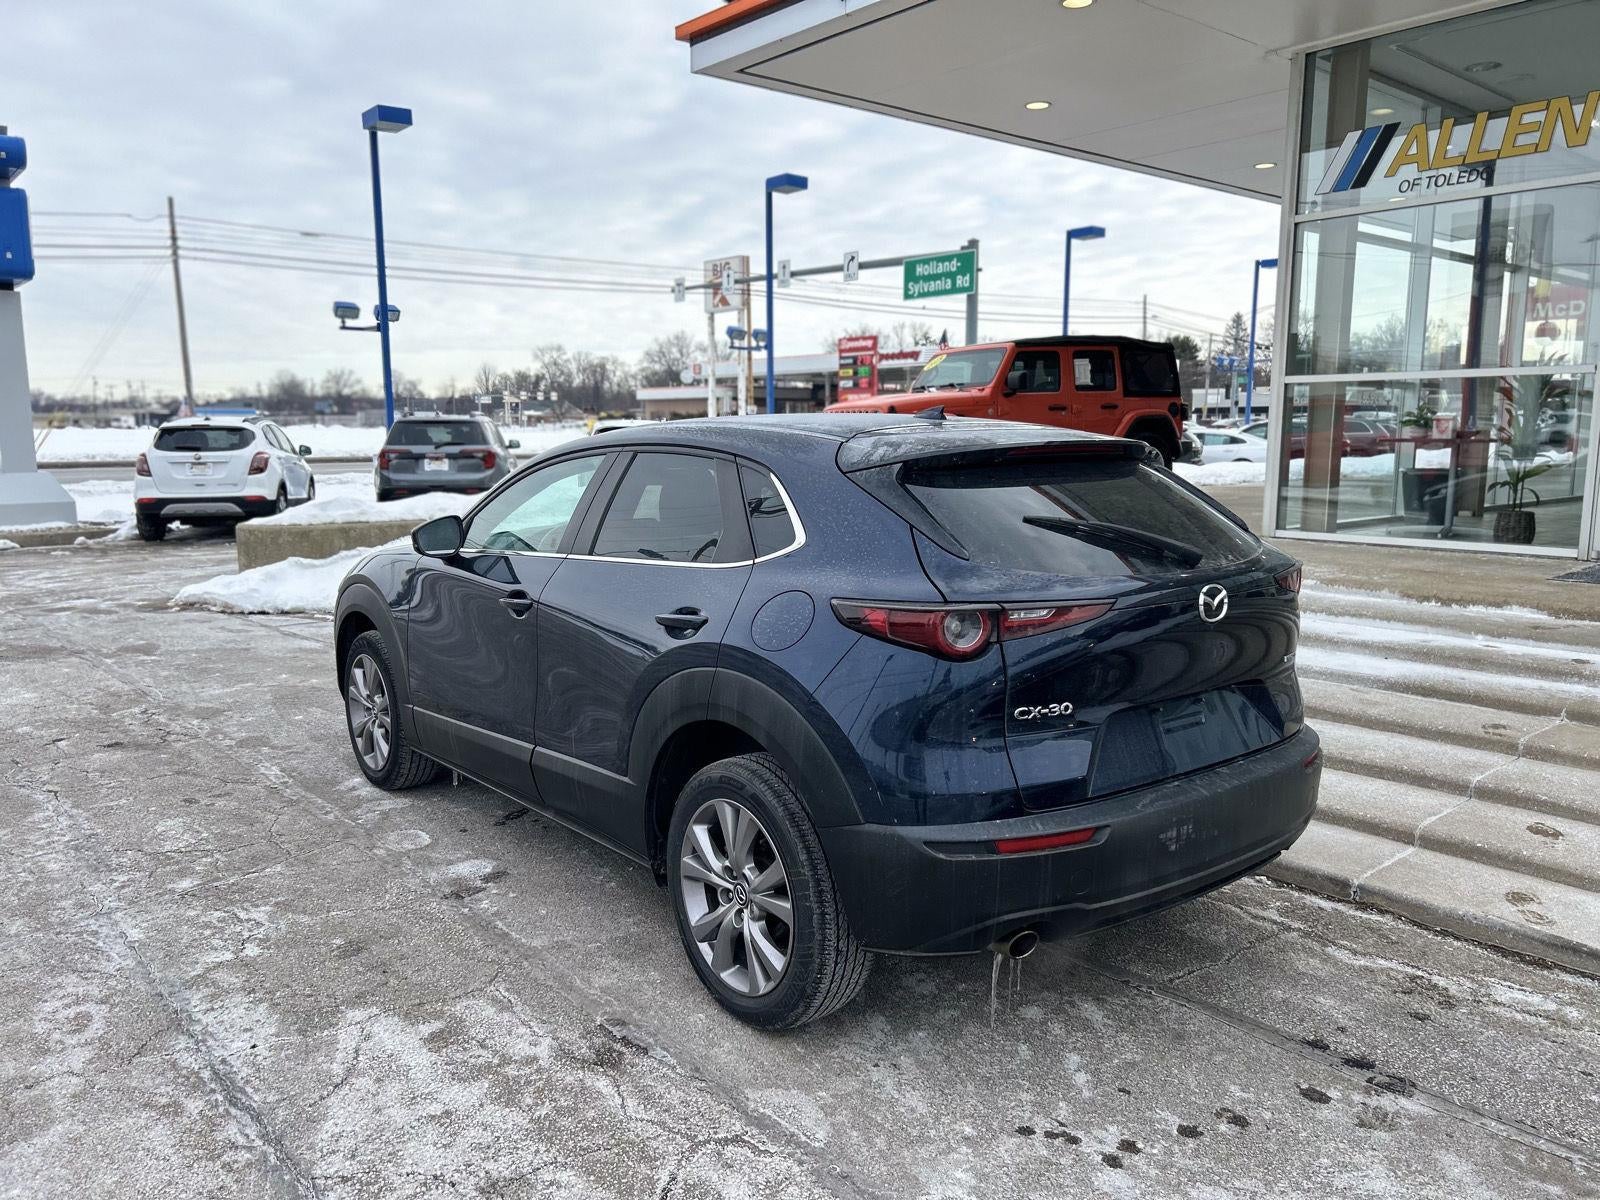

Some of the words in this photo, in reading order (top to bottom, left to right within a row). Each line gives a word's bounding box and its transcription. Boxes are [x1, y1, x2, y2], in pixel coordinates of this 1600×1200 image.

[1384, 89, 1600, 178] ALLEN
[1398, 177, 1422, 193] OF
[915, 257, 962, 277] Holland-
[907, 277, 952, 297] Sylvania
[955, 273, 970, 289] Rd
[878, 349, 921, 362] peedway
[1013, 702, 1073, 719] CX-30
